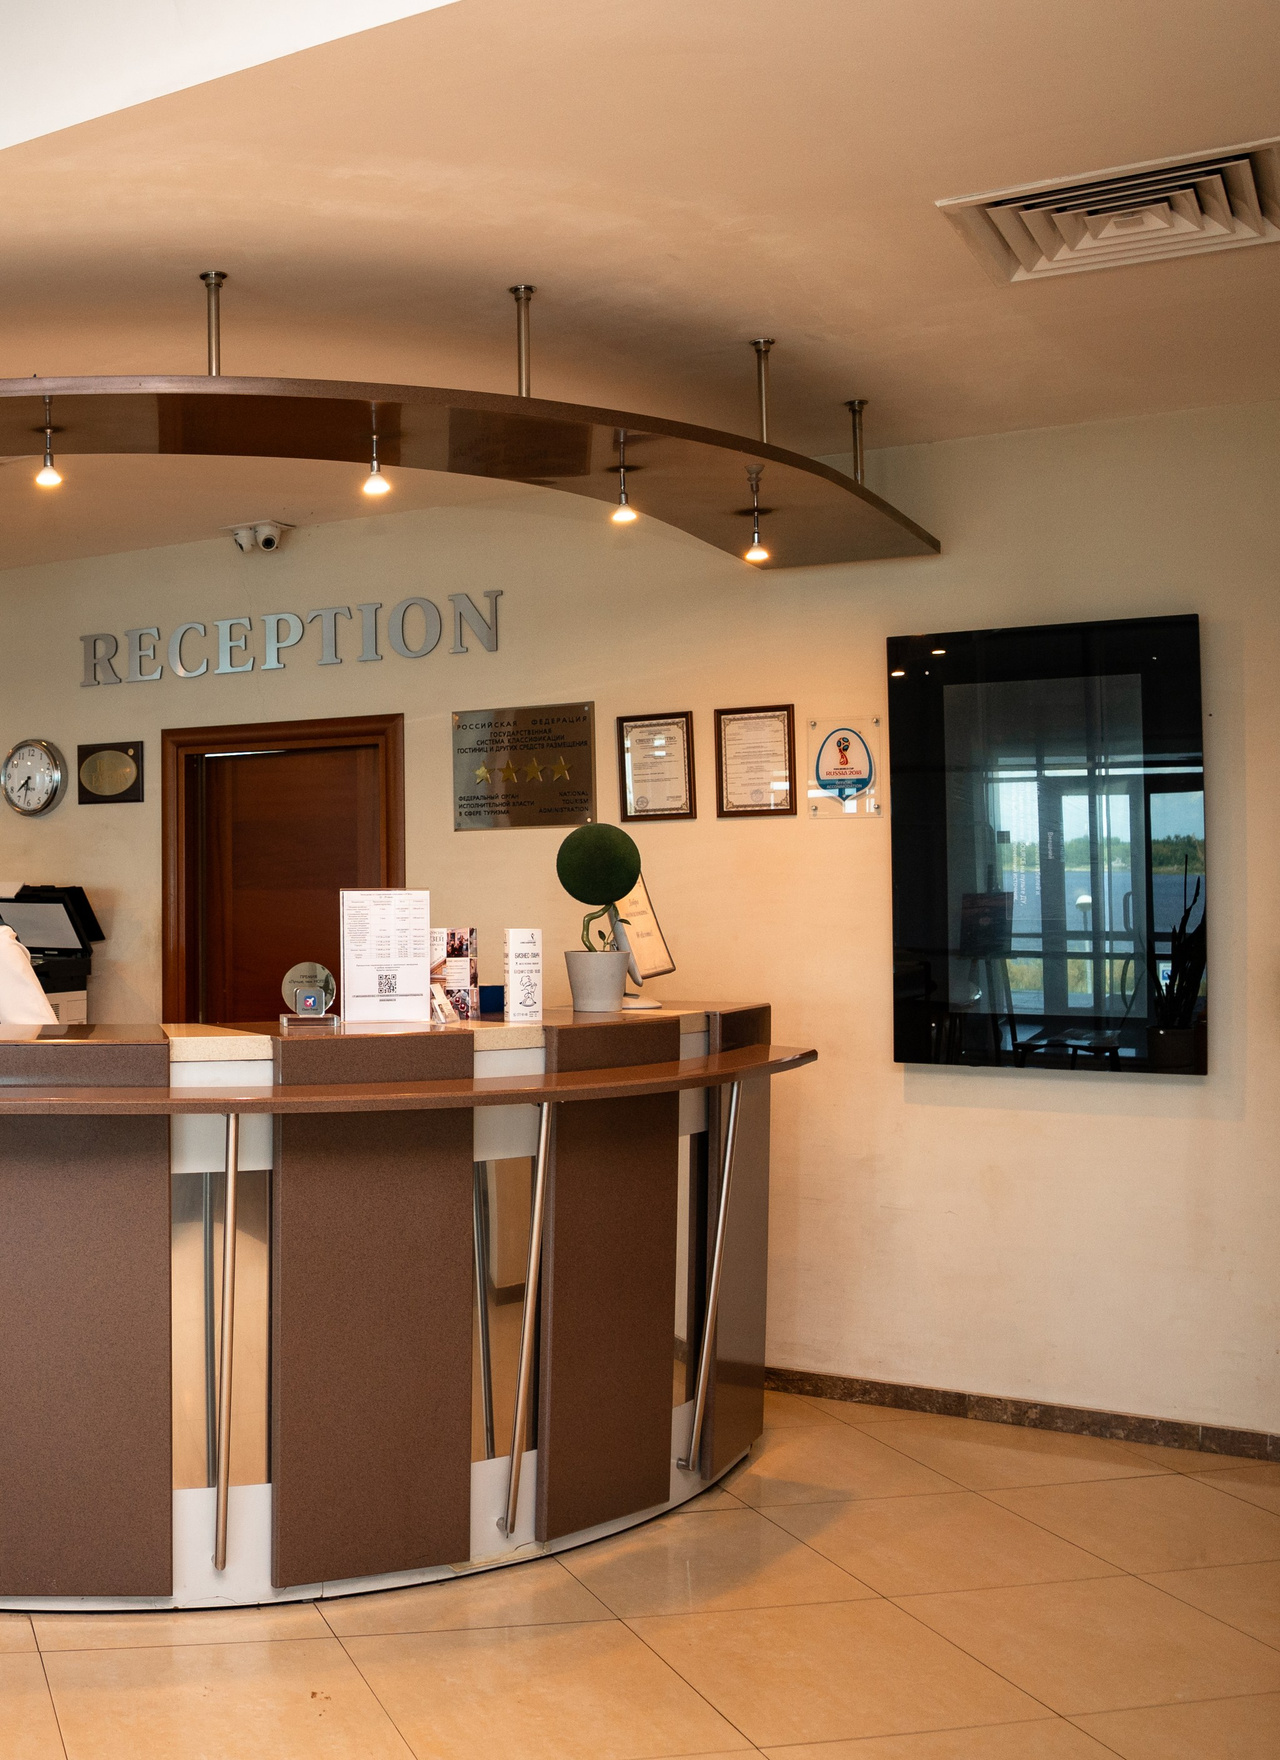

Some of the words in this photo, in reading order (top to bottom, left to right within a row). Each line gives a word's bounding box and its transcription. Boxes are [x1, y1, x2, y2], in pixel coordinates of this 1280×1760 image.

[79, 589, 503, 687] RECEPTION
[457, 720, 518, 730] РОССИЙСКАЯ
[531, 716, 588, 726] ФЕДЕРАЦИЯ
[490, 728, 552, 738] ГОСУДАРСТВЕННАЯ
[508, 735, 565, 744] КЛАССИФИКАЦИИ
[495, 745, 518, 753] ДРУГИХ
[519, 743, 545, 751] СРЕДСТВ
[546, 740, 588, 749] РАЗМЕЩЕНИЯ
[28, 749, 35, 757] 12
[10, 786, 14, 794] 8
[459, 793, 499, 802] ФЕДЕРАЛЬНЫЙ
[27, 799, 31, 807] 6
[459, 801, 510, 809] ИСПОЛНИТЕЛЬНОЙ
